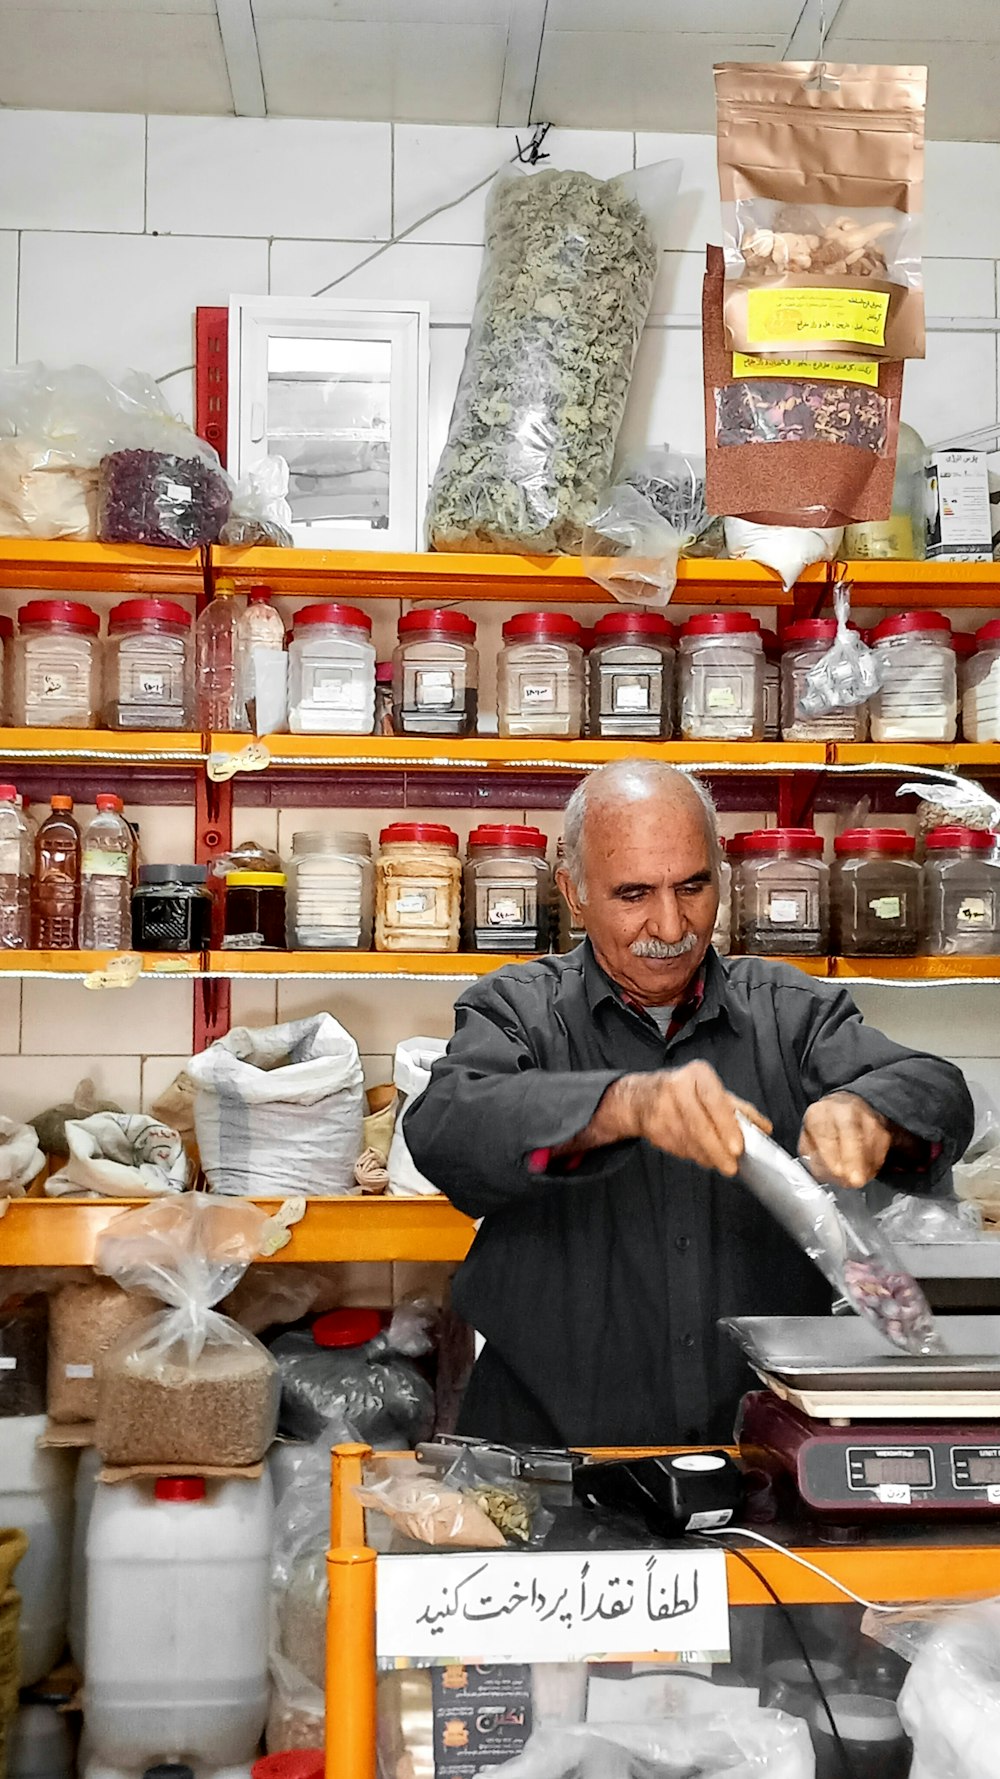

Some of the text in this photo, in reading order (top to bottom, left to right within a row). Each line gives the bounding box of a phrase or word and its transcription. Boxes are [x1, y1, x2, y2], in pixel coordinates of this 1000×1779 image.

[416, 1563, 489, 1635] کنید
[463, 1578, 573, 1629] پرداخت
[645, 1555, 698, 1621] لطفاً
